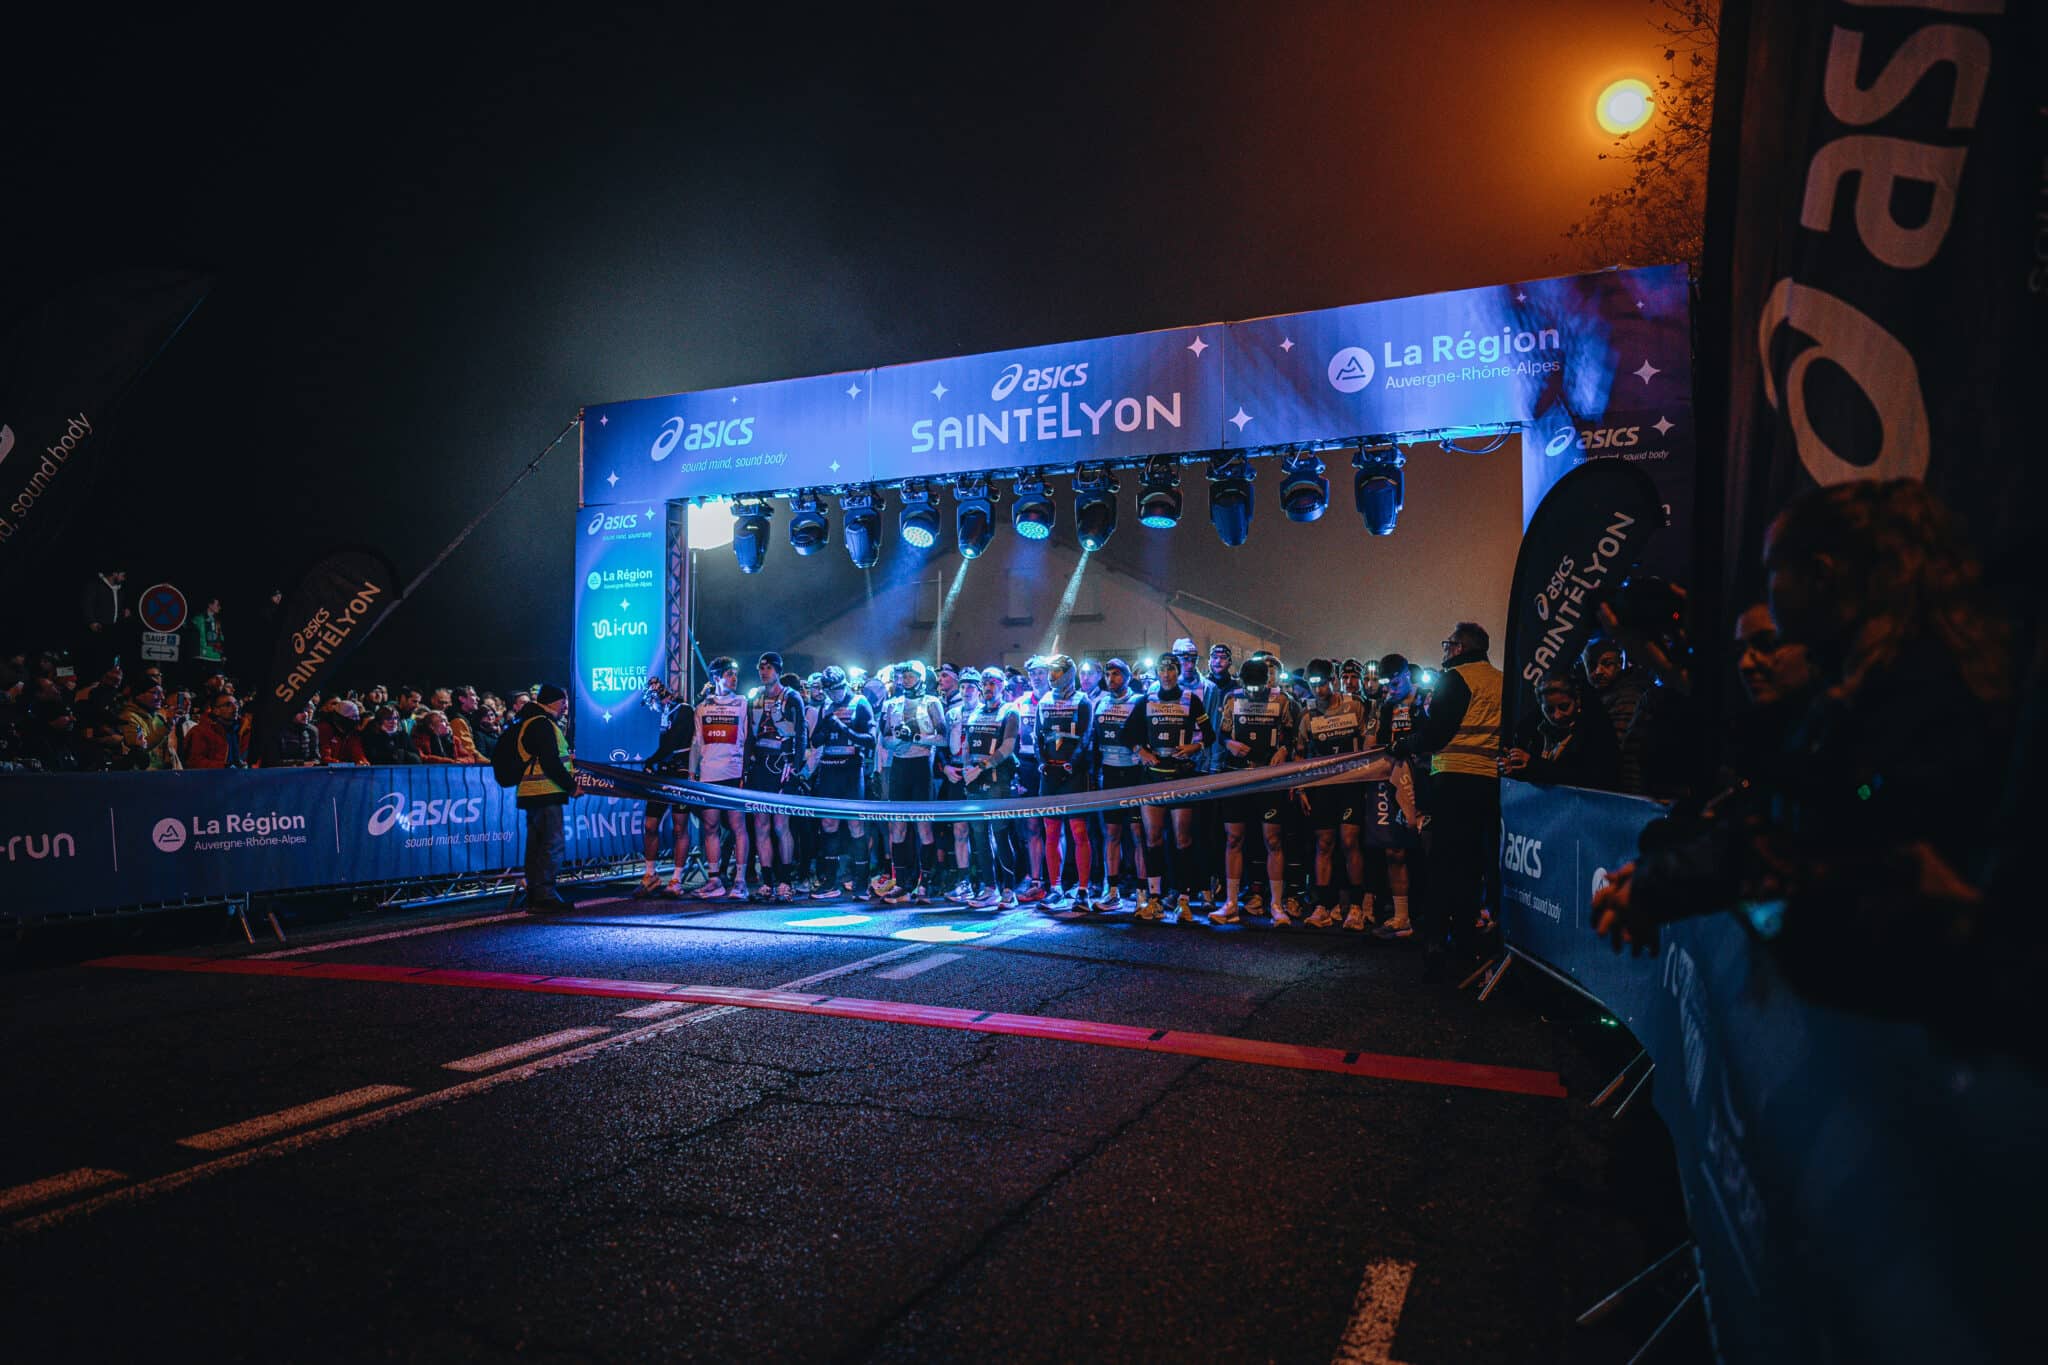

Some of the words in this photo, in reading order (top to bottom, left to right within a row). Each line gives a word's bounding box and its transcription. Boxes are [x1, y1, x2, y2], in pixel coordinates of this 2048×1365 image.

[1384, 341, 1422, 368] La
[1432, 326, 1560, 363] Région
[1022, 362, 1088, 393] asics
[1385, 357, 1561, 390] Auvergne-Rhône-Alpes
[684, 417, 755, 451] asics
[911, 392, 1182, 453] SAINTÉLYON
[1576, 426, 1640, 450] asics
[11, 454, 58, 518] sound
[47, 412, 94, 463] body
[681, 459, 707, 473] sound
[708, 457, 731, 470] mind,
[735, 454, 762, 468] sound
[764, 451, 789, 466] body
[603, 513, 638, 531] asics
[603, 570, 615, 582] La
[616, 568, 653, 582] Région
[1546, 555, 1575, 600] asics
[1522, 511, 1636, 688] SAINTÉLYON
[144, 634, 166, 643] SAUF
[303, 607, 330, 641] asics
[613, 617, 648, 637] i-run
[274, 580, 382, 703] SAINTÉLYON
[613, 665, 636, 676] VILLE
[636, 665, 648, 675] DE
[613, 675, 647, 692] LYON
[193, 816, 220, 836] La
[227, 811, 306, 836] Région
[408, 798, 482, 827] asics
[194, 834, 307, 852] Auvergne-Rhône-Alpes
[404, 835, 433, 849] sound
[435, 833, 461, 846] mind,
[463, 831, 490, 845] sound
[492, 829, 514, 844] body
[1505, 832, 1542, 879] asics
